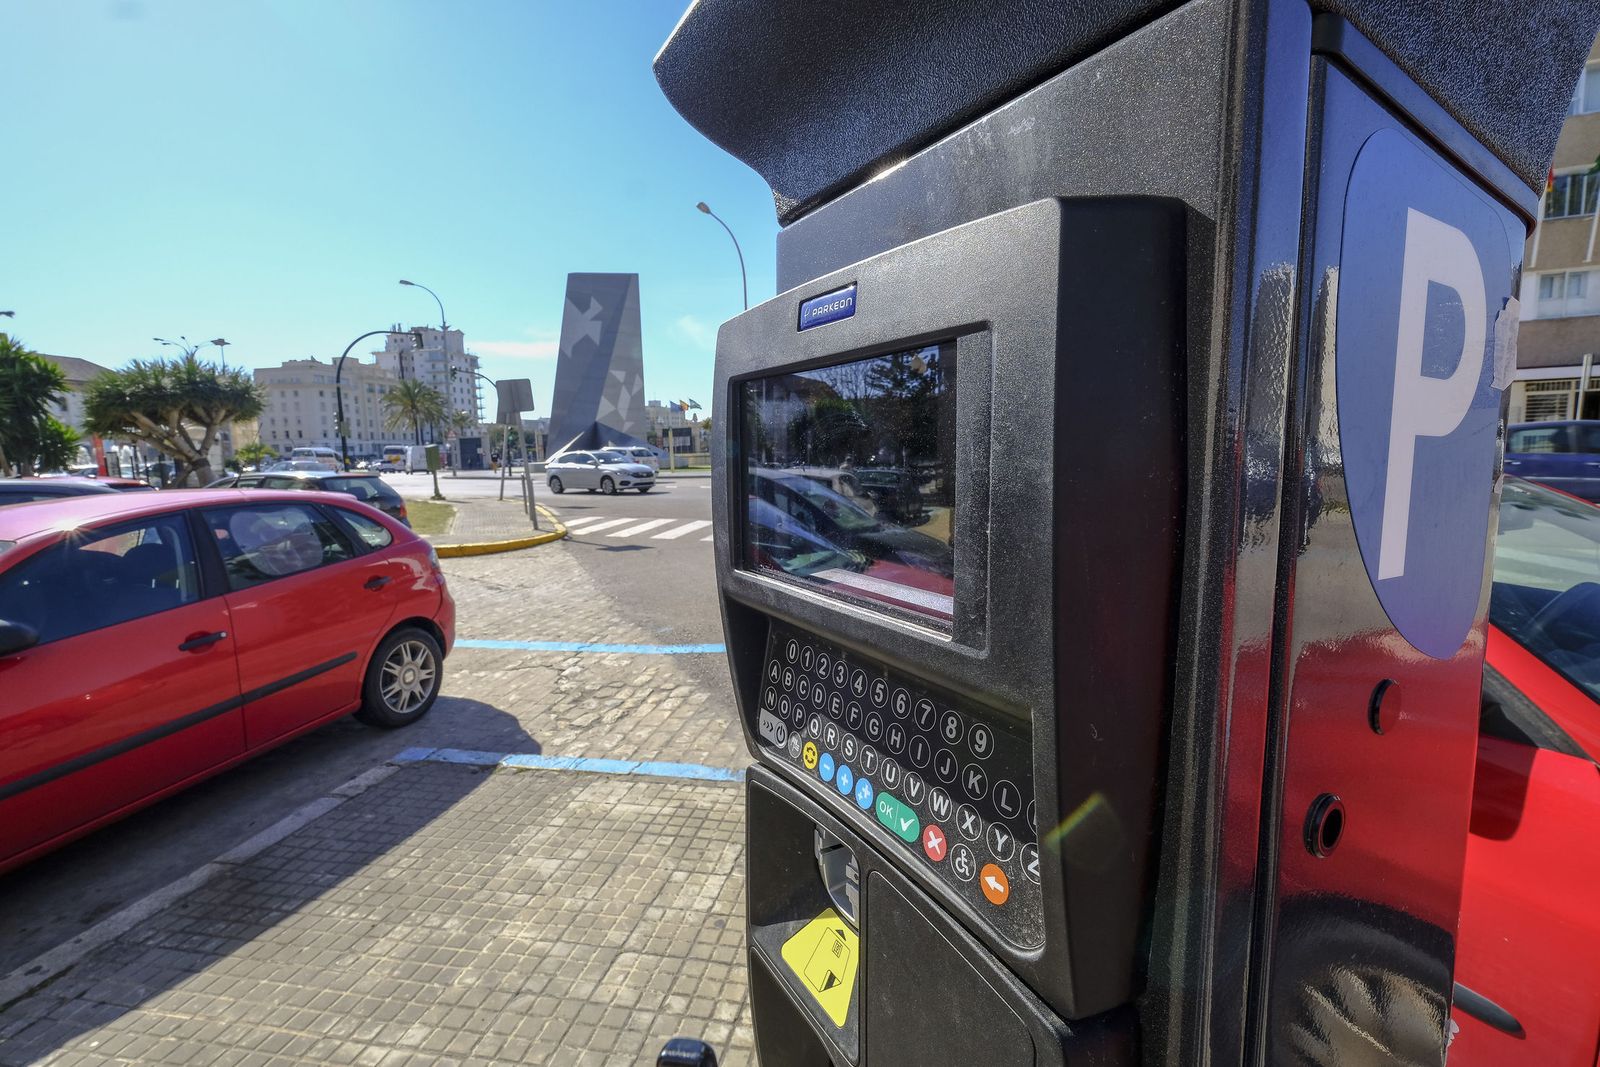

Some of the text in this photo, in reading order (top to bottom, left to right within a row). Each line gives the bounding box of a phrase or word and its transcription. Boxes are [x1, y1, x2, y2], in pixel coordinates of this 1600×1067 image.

[812, 297, 853, 317] PARKEON
[1377, 206, 1487, 580] P
[771, 665, 778, 679] A
[785, 672, 792, 686] B
[800, 680, 807, 695] C
[815, 688, 823, 703] D
[831, 697, 840, 714] E
[850, 707, 859, 722] F
[869, 718, 879, 736] G
[890, 729, 901, 748] H
[940, 757, 951, 775] J
[968, 770, 982, 794] K
[1001, 787, 1012, 812] L
[789, 643, 796, 660] 0
[819, 657, 827, 676] 2
[836, 665, 844, 684] 3
[854, 675, 863, 693] 4
[874, 683, 885, 703] 5
[896, 693, 906, 714] 6
[921, 703, 932, 725] 7
[946, 716, 957, 739] 8
[974, 729, 987, 753] 9
[768, 691, 774, 706] N
[781, 700, 788, 714] O
[795, 708, 803, 722] P
[810, 718, 818, 736] Q
[827, 727, 836, 746] R
[845, 739, 853, 756] S
[865, 750, 874, 768] T
[885, 763, 896, 783] U
[910, 777, 920, 797] V
[933, 791, 949, 816] W
[961, 810, 976, 835] X
[995, 828, 1009, 852] Y
[879, 800, 894, 819] OK
